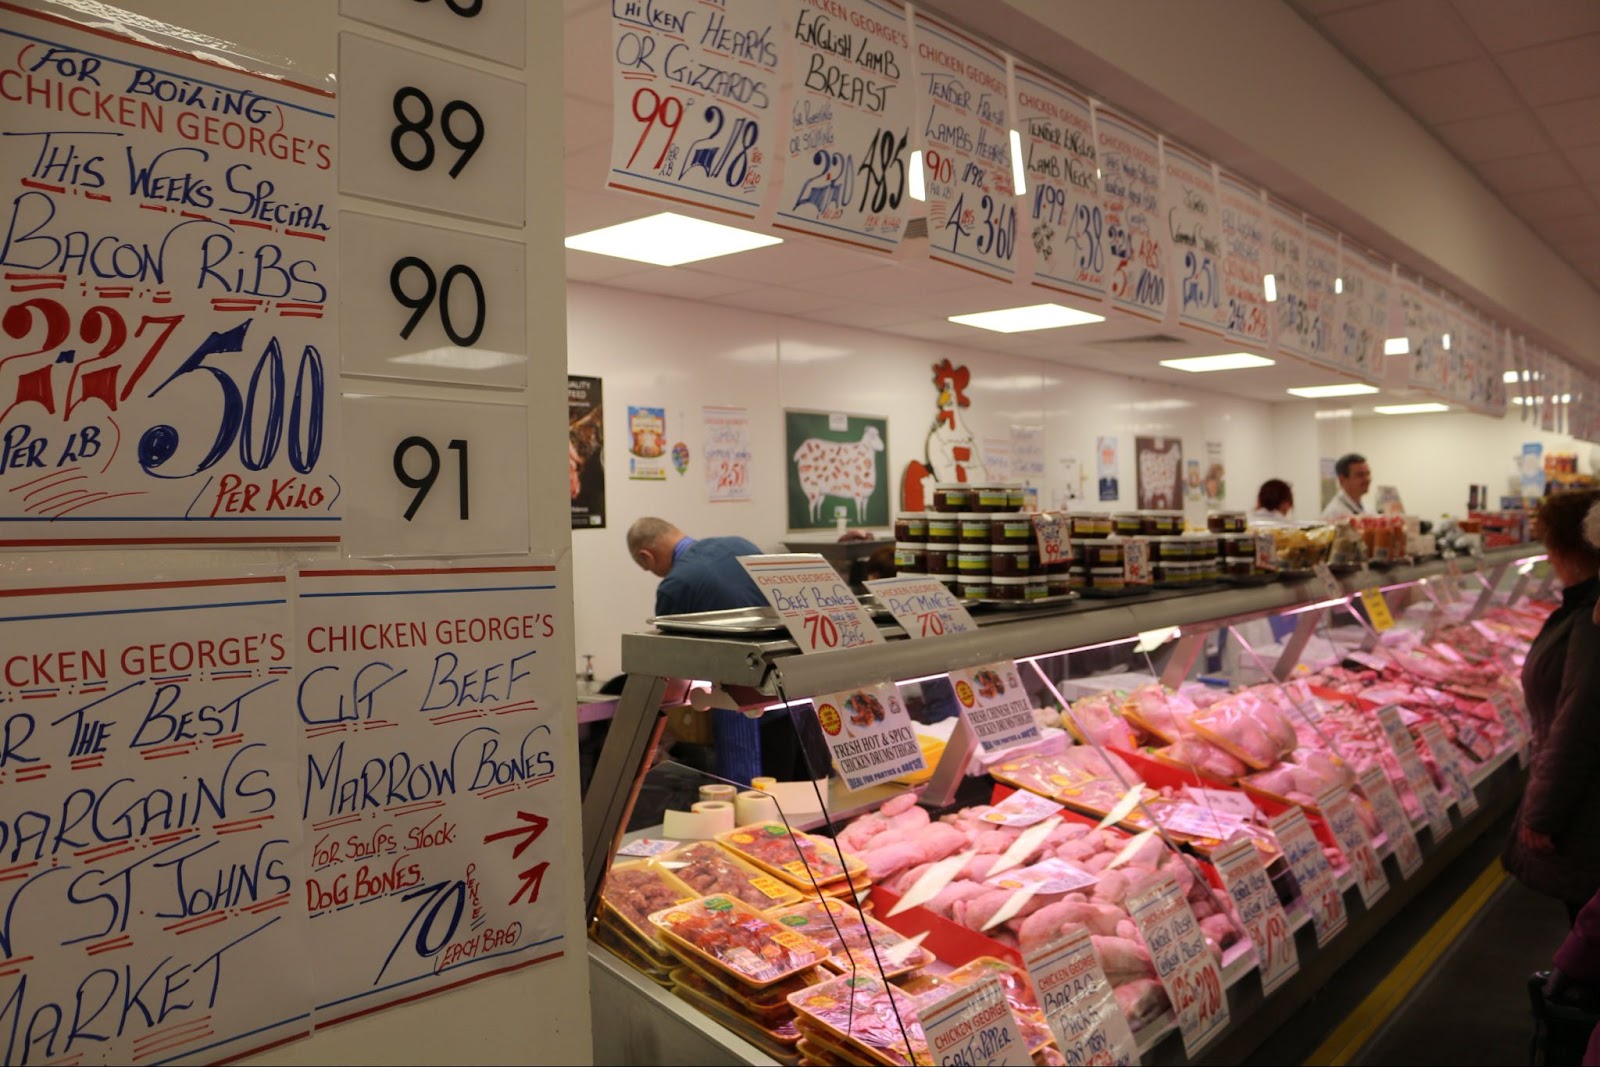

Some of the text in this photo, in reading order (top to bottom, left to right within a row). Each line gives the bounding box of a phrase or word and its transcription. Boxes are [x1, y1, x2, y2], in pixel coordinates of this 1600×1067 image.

[849, 12, 910, 49] GEORGE'S
[616, 32, 655, 73] OR
[855, 38, 900, 80] LAMB
[918, 44, 964, 76] CHICKEN
[805, 53, 897, 111] BREAST
[920, 72, 972, 112] TENDER
[0, 69, 332, 171] CHICKEN GEORGE'S
[1018, 91, 1058, 120] CHICKEN
[390, 86, 485, 179] 89
[626, 87, 684, 170] 99
[925, 104, 972, 152] LAMBS
[126, 146, 214, 209] WEEKS
[925, 150, 951, 184] 90
[1027, 143, 1060, 179] LAMB
[0, 191, 235, 285] BACON
[390, 256, 486, 347] 90
[393, 435, 469, 521] 91
[757, 571, 842, 587] CHICKEN GEORGE'S
[771, 582, 856, 612] BEEF BONES
[875, 587, 908, 598] CHICKEN
[888, 599, 917, 615] PET
[916, 612, 945, 638] 70
[306, 613, 555, 654] CHICKEN GEORGE'S
[803, 614, 839, 650] 70
[841, 622, 865, 647] BAG
[119, 632, 287, 677] GEORGE'S
[297, 650, 537, 725] CUT BEEF
[1009, 699, 1029, 715] STYLE
[51, 680, 147, 757] THE
[129, 679, 280, 748] BEST
[833, 726, 913, 759] FRESH HOT & SPICY
[840, 751, 873, 774] CHICKEN
[302, 724, 556, 821] MARROW BONES
[311, 834, 342, 868] FOR
[152, 839, 291, 918] JOHNS
[306, 873, 348, 913] DOG
[373, 862, 481, 986] 70 PENCE
[1038, 954, 1097, 991] CHICKEN GEORGE
[934, 1000, 1007, 1050] CHICKEN GEORGE
